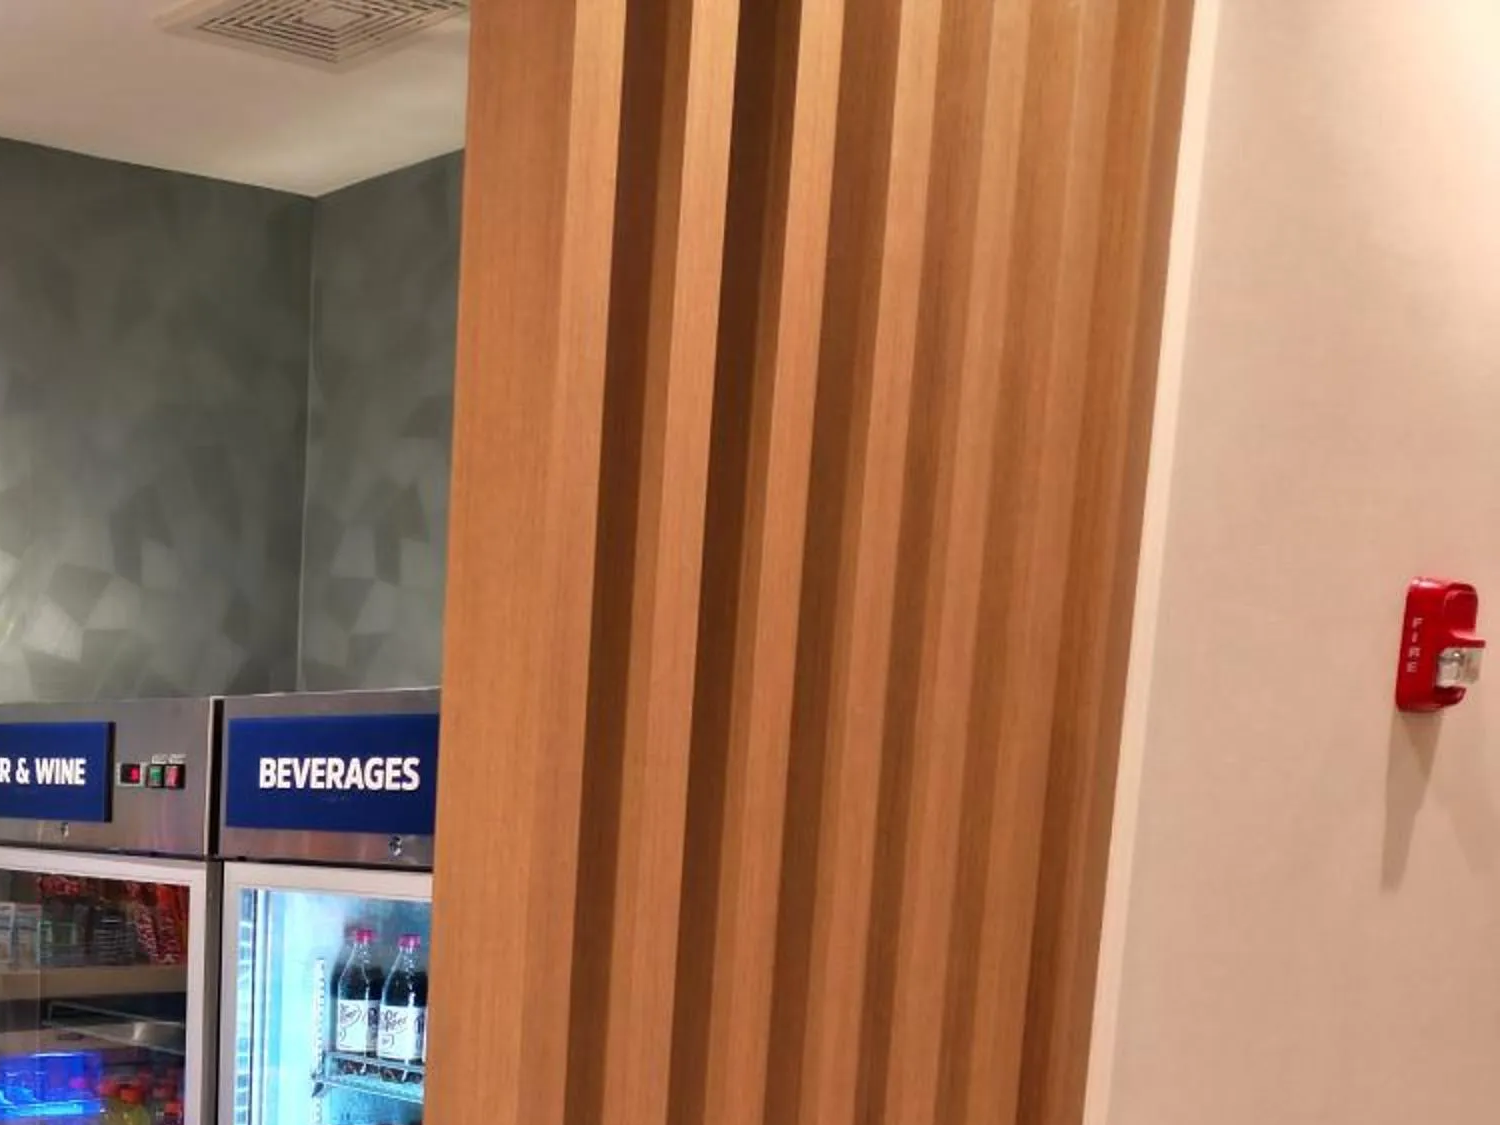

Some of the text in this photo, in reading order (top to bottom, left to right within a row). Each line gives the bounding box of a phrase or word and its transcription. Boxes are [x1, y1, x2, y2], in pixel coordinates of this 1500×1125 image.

[1406, 617, 1423, 673] FIRE
[16, 758, 29, 783] &
[34, 757, 86, 786] WINE
[258, 756, 421, 791] BEVERAGES
